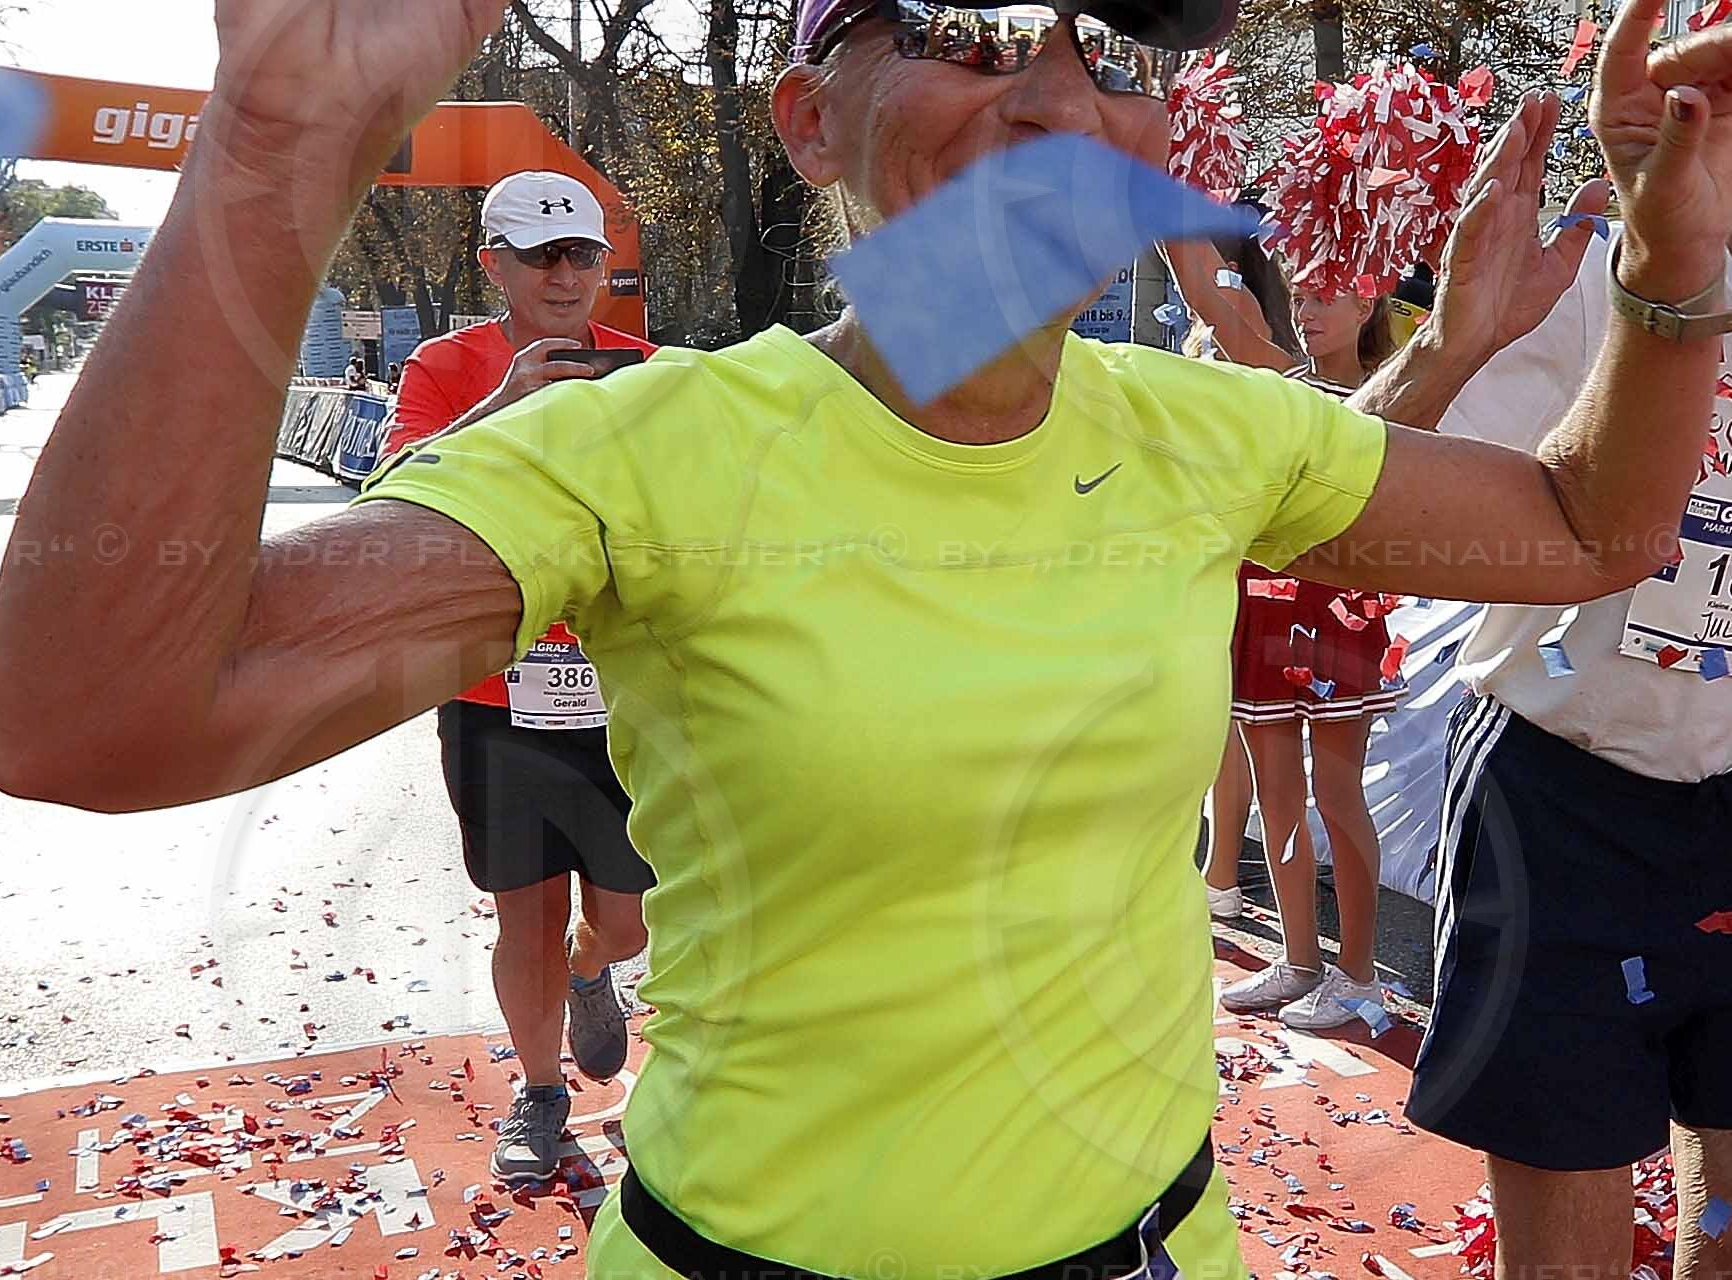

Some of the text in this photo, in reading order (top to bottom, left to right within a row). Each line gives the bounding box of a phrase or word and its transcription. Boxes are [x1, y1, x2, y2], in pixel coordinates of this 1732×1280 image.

[76, 239, 118, 253] ERSTE
[85, 285, 126, 300] KLE
[537, 643, 570, 653] GRAZ
[548, 667, 593, 688] 386
[553, 698, 587, 708] Gerald
